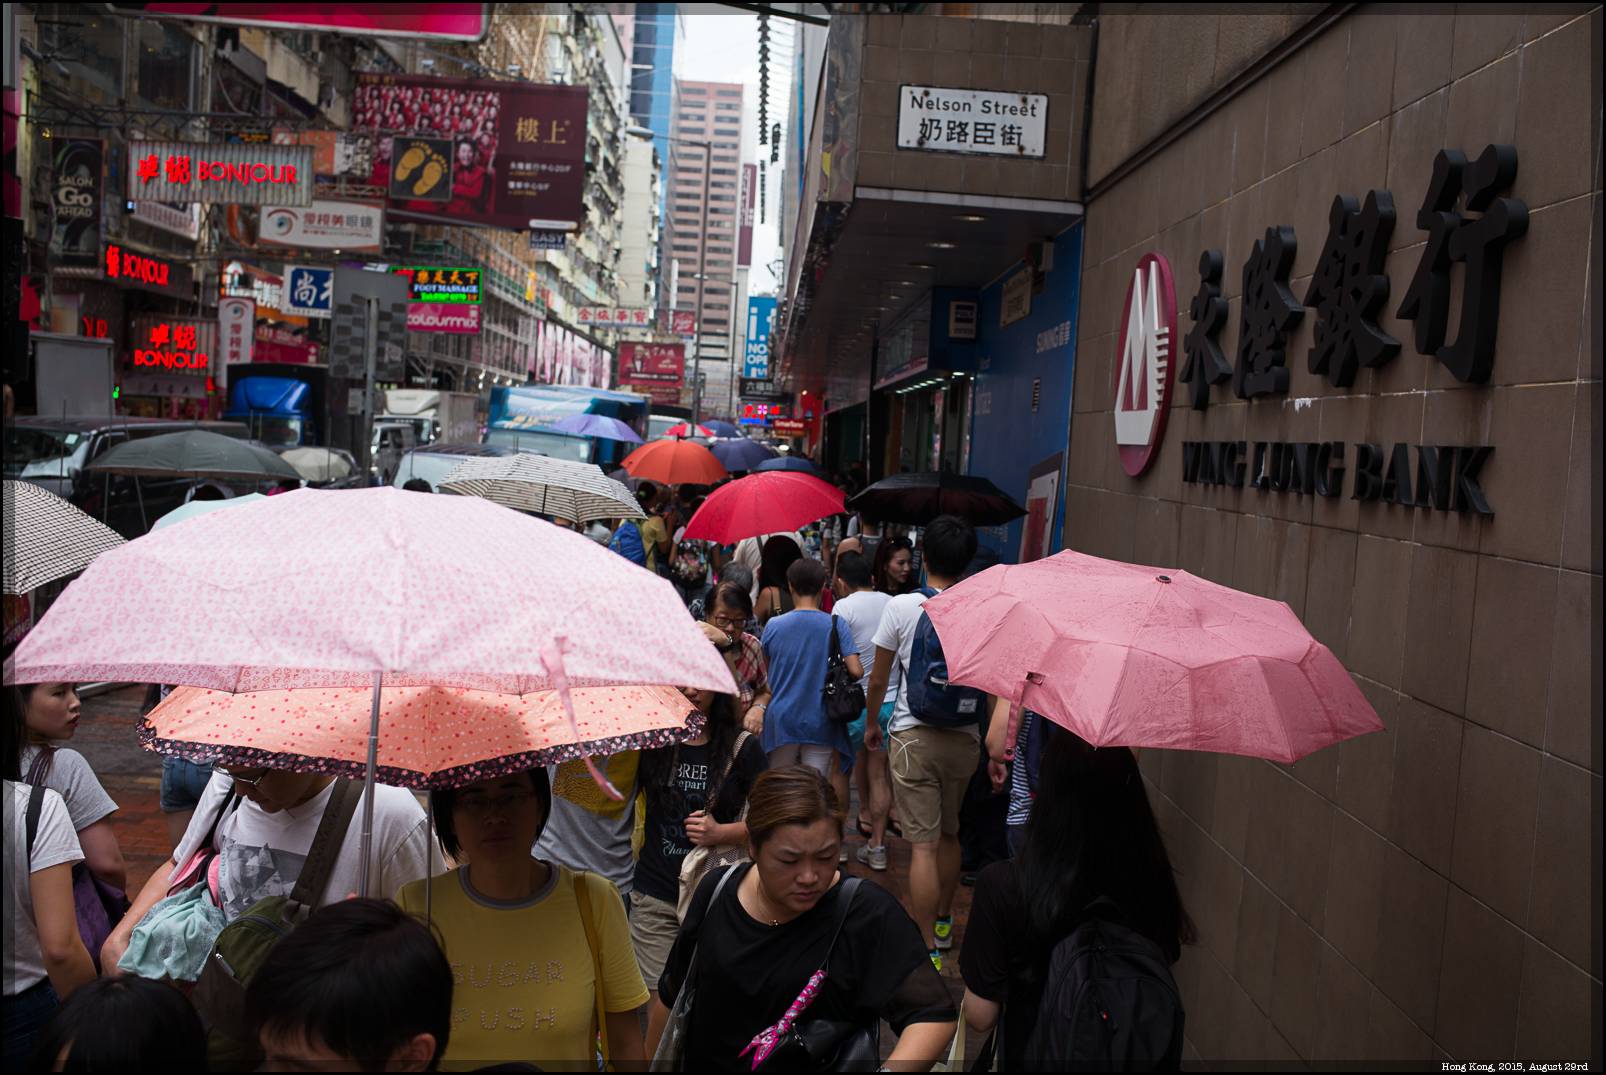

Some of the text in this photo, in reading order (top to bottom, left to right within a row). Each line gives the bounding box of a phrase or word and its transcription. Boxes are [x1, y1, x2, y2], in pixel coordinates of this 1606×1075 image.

[911, 95, 1037, 117] Nelson Street
[514, 116, 567, 145] 樓上
[919, 117, 1023, 146] 奶路臣街
[59, 176, 93, 187] SALON
[198, 161, 297, 186] BONJOUR
[57, 207, 93, 218] AHEAD
[122, 253, 169, 287] BONJOUR
[1177, 143, 1530, 411] 永隆銀行
[414, 283, 479, 293] FOOT MASSAGE
[133, 349, 208, 369] BONJOUR
[748, 343, 767, 355] NO
[1182, 442, 1496, 518] WING LUNG BANK
[454, 1007, 558, 1031] PUSH
